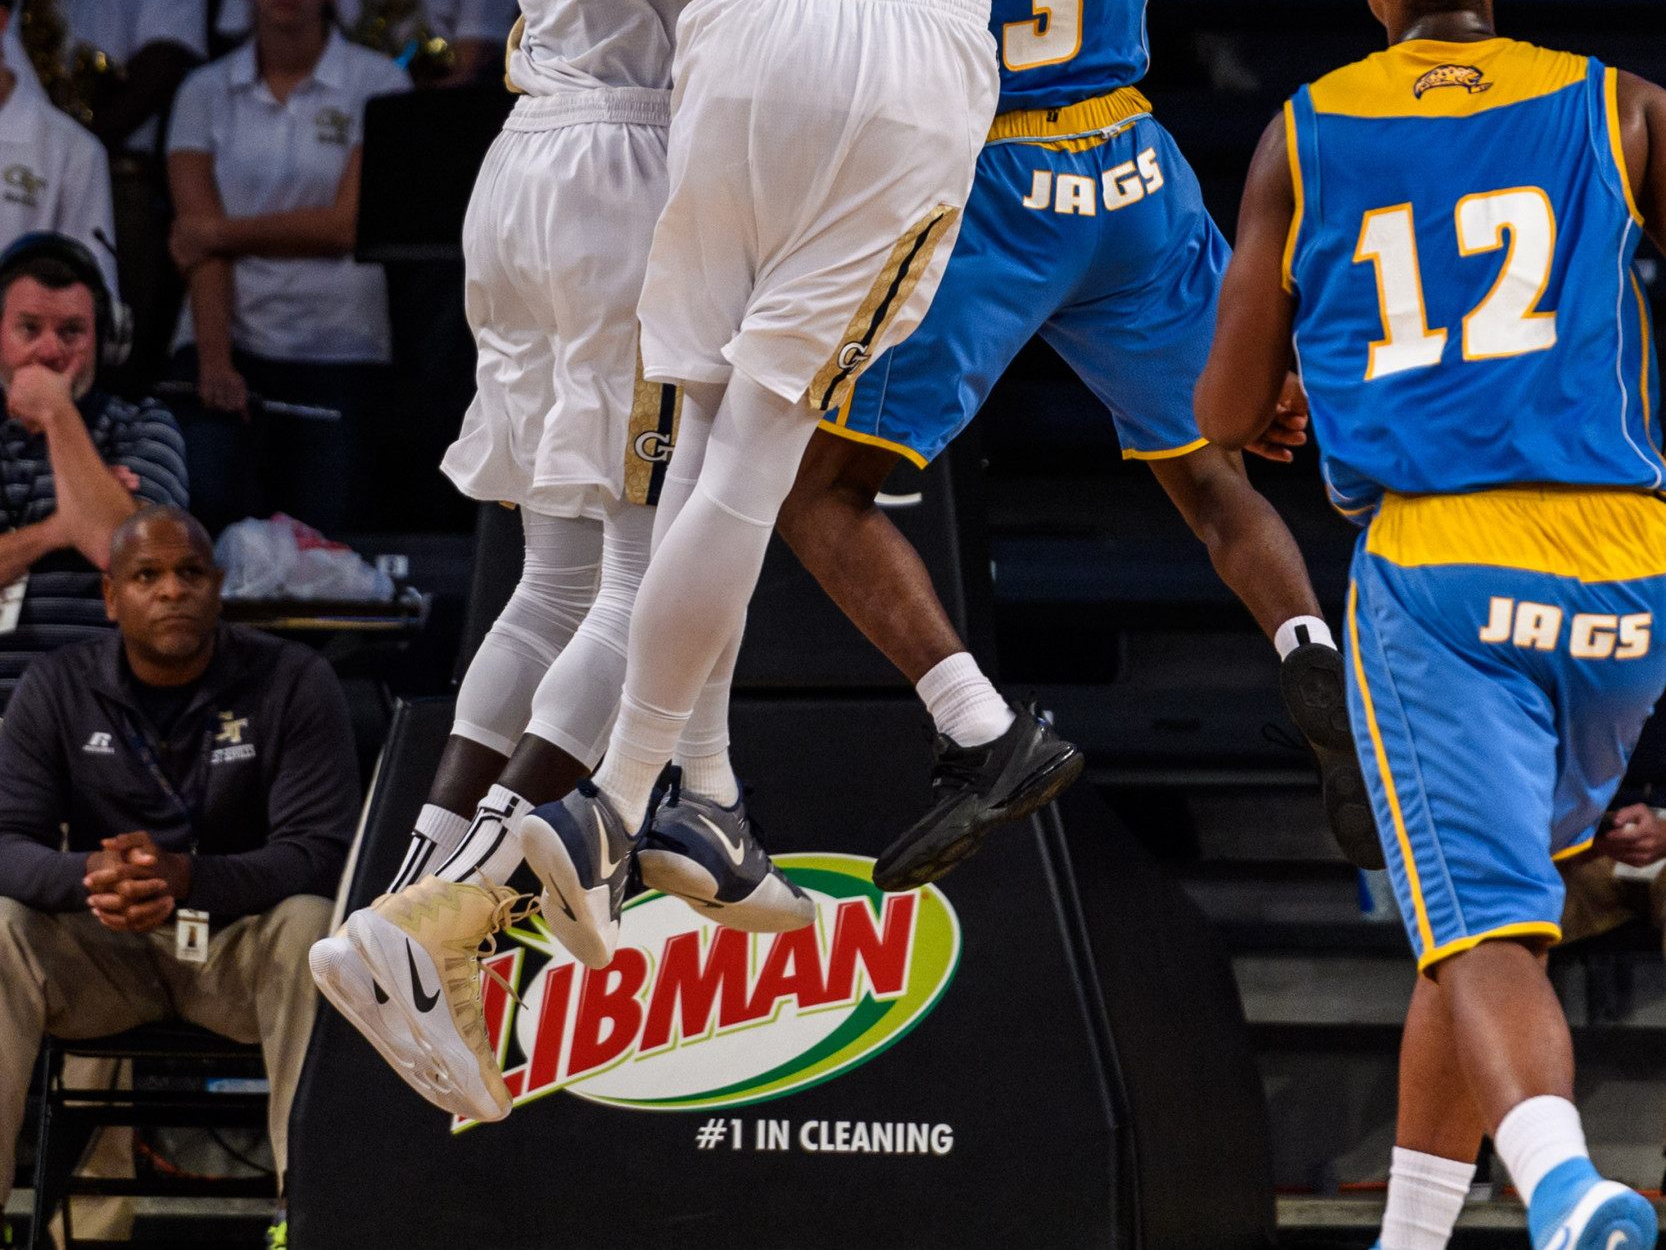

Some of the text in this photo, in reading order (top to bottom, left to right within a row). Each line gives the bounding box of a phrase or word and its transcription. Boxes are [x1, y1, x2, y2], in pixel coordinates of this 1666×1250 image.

[1022, 147, 1164, 216] JAGS
[1352, 185, 1558, 382] 12
[1479, 596, 1653, 660] JAGS
[697, 1119, 954, 1155] #1 IN CLEANING
